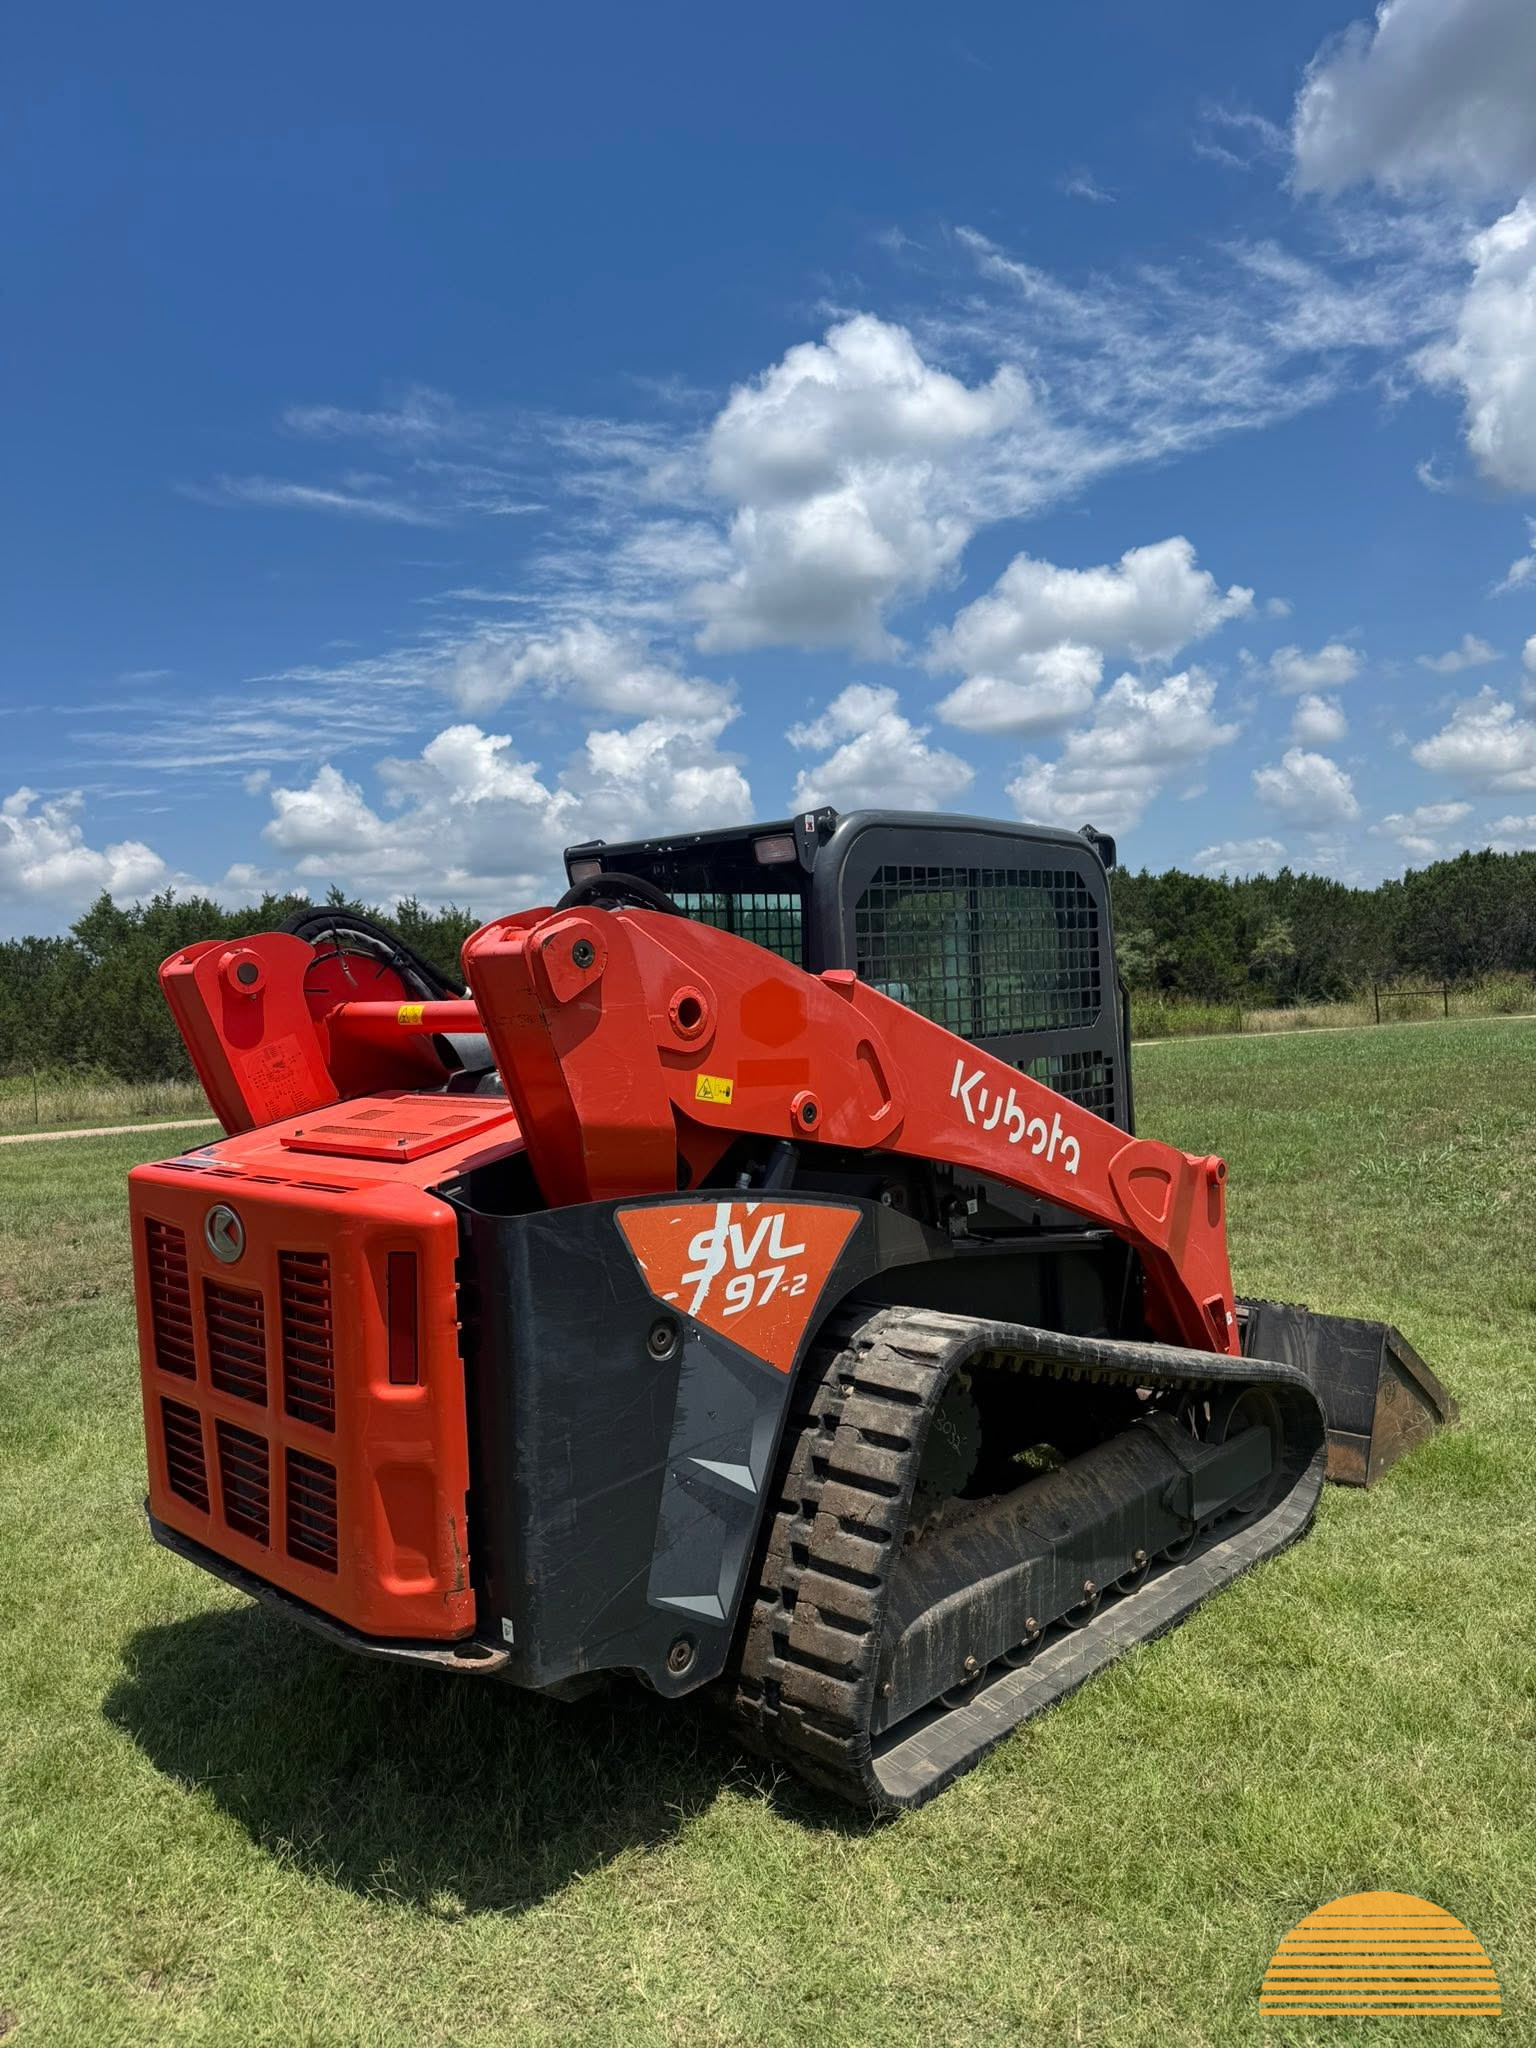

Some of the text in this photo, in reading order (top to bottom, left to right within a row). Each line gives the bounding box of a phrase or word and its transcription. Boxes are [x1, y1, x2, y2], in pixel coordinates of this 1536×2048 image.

[950, 1058, 1081, 1176] Kubota
[680, 1212, 807, 1286] SVL
[722, 1264, 809, 1317] 97-2
